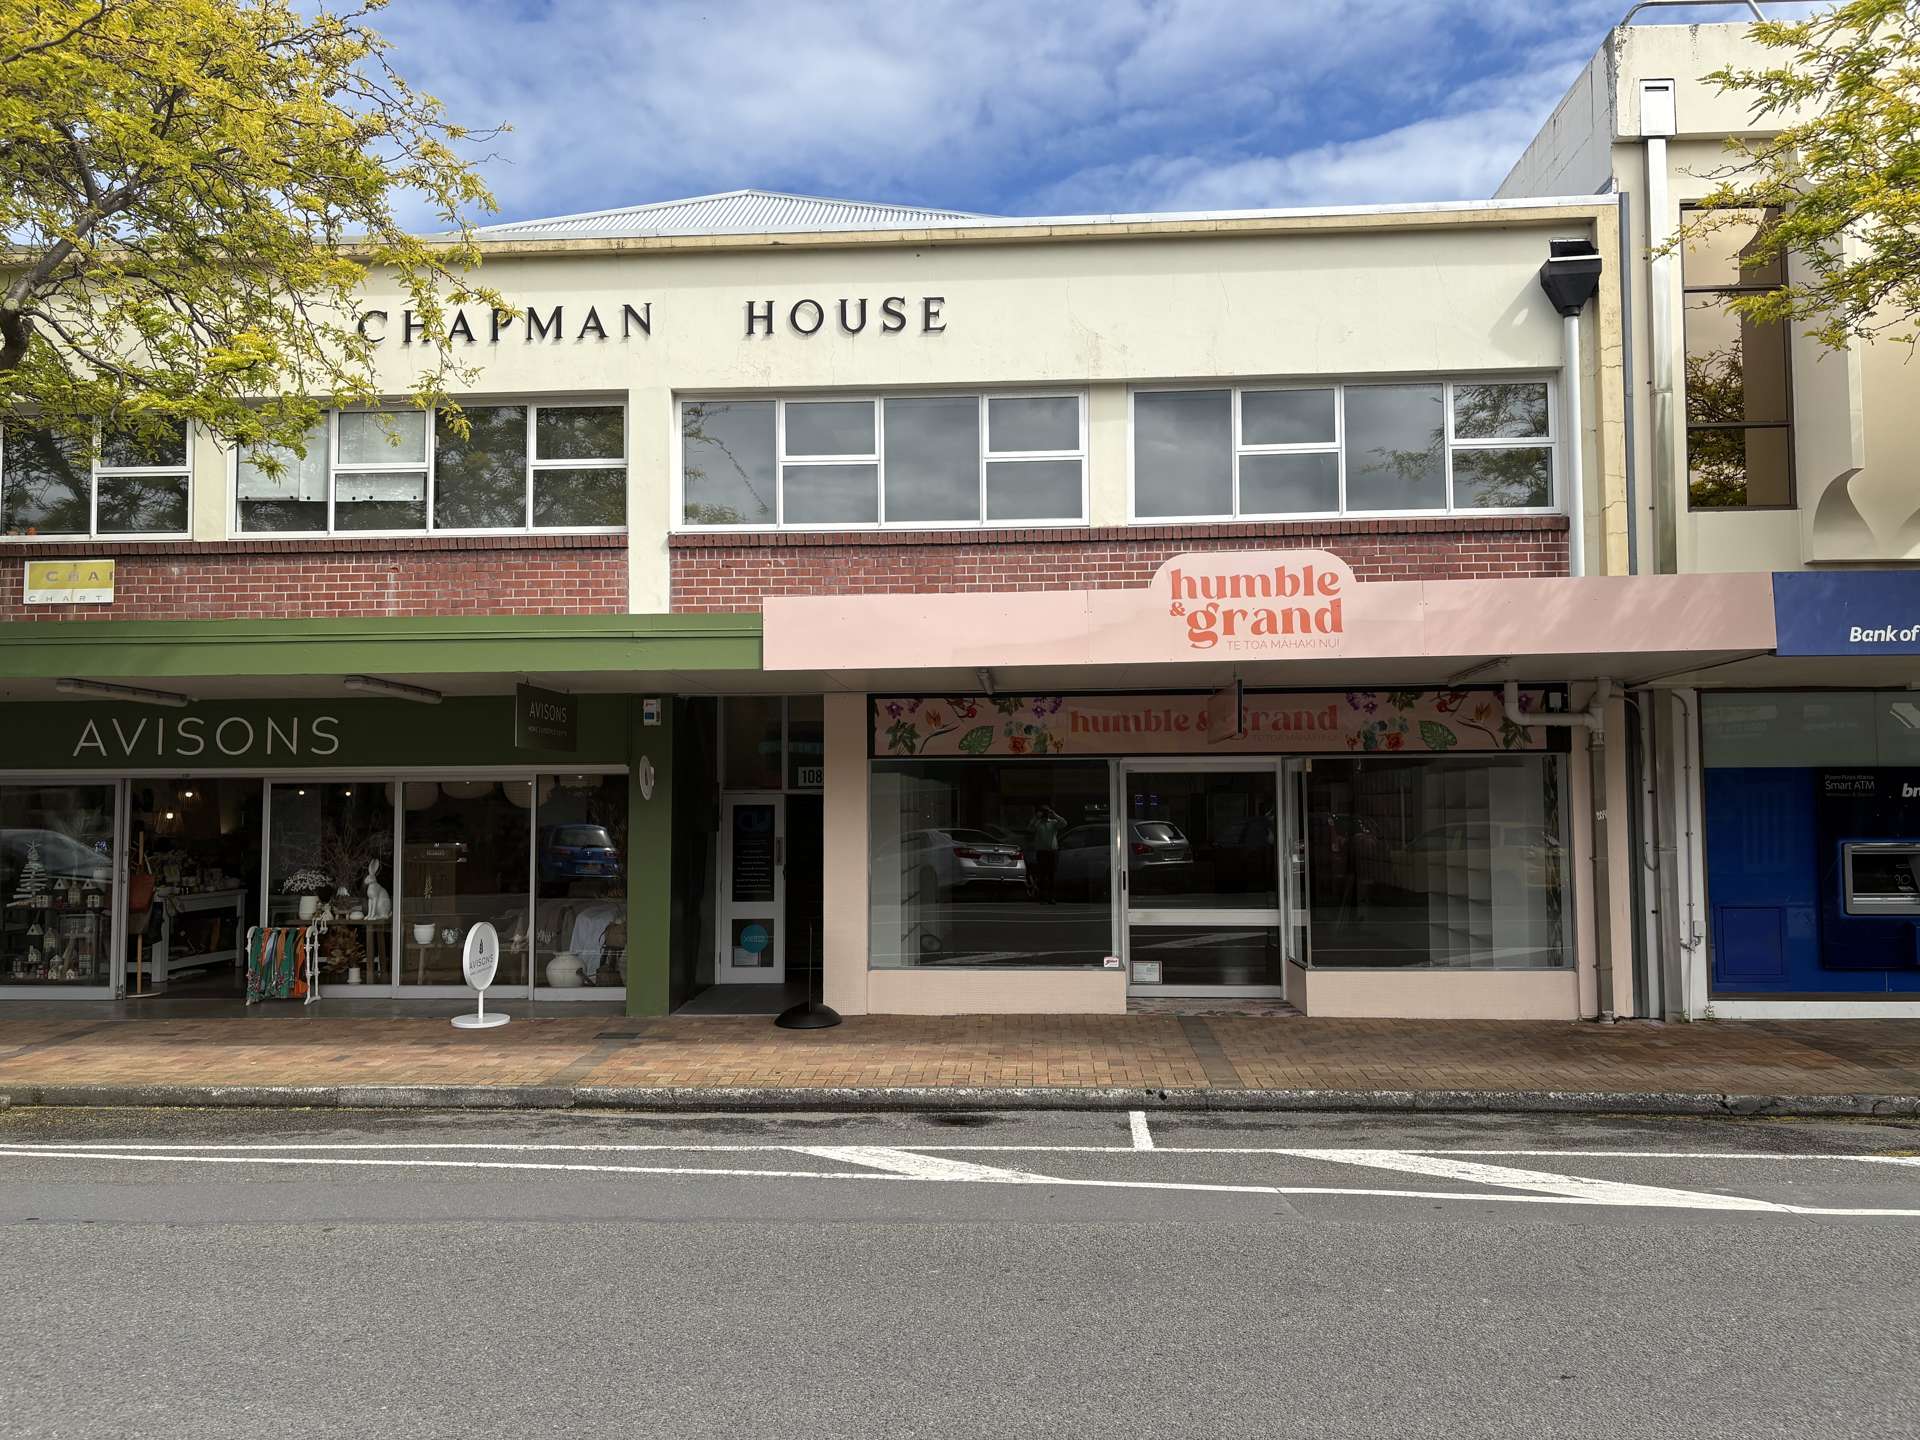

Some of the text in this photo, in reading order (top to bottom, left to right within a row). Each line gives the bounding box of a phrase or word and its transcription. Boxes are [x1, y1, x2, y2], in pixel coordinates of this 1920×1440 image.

[357, 297, 948, 343] CHAPMAN HOUSE
[1170, 565, 1342, 600] humble
[1169, 598, 1344, 649] & grand
[1849, 625, 1920, 642] Bank of
[1227, 640, 1240, 650] TE
[1243, 640, 1268, 650] TOA
[1270, 639, 1316, 649] MAHAKI
[529, 700, 568, 724] AVISONS
[1070, 708, 1190, 733] humble
[1243, 704, 1338, 737] rand
[72, 716, 340, 757] AVISONS
[1824, 780, 1875, 791] Smart ATM
[469, 953, 494, 970] AVISONS
